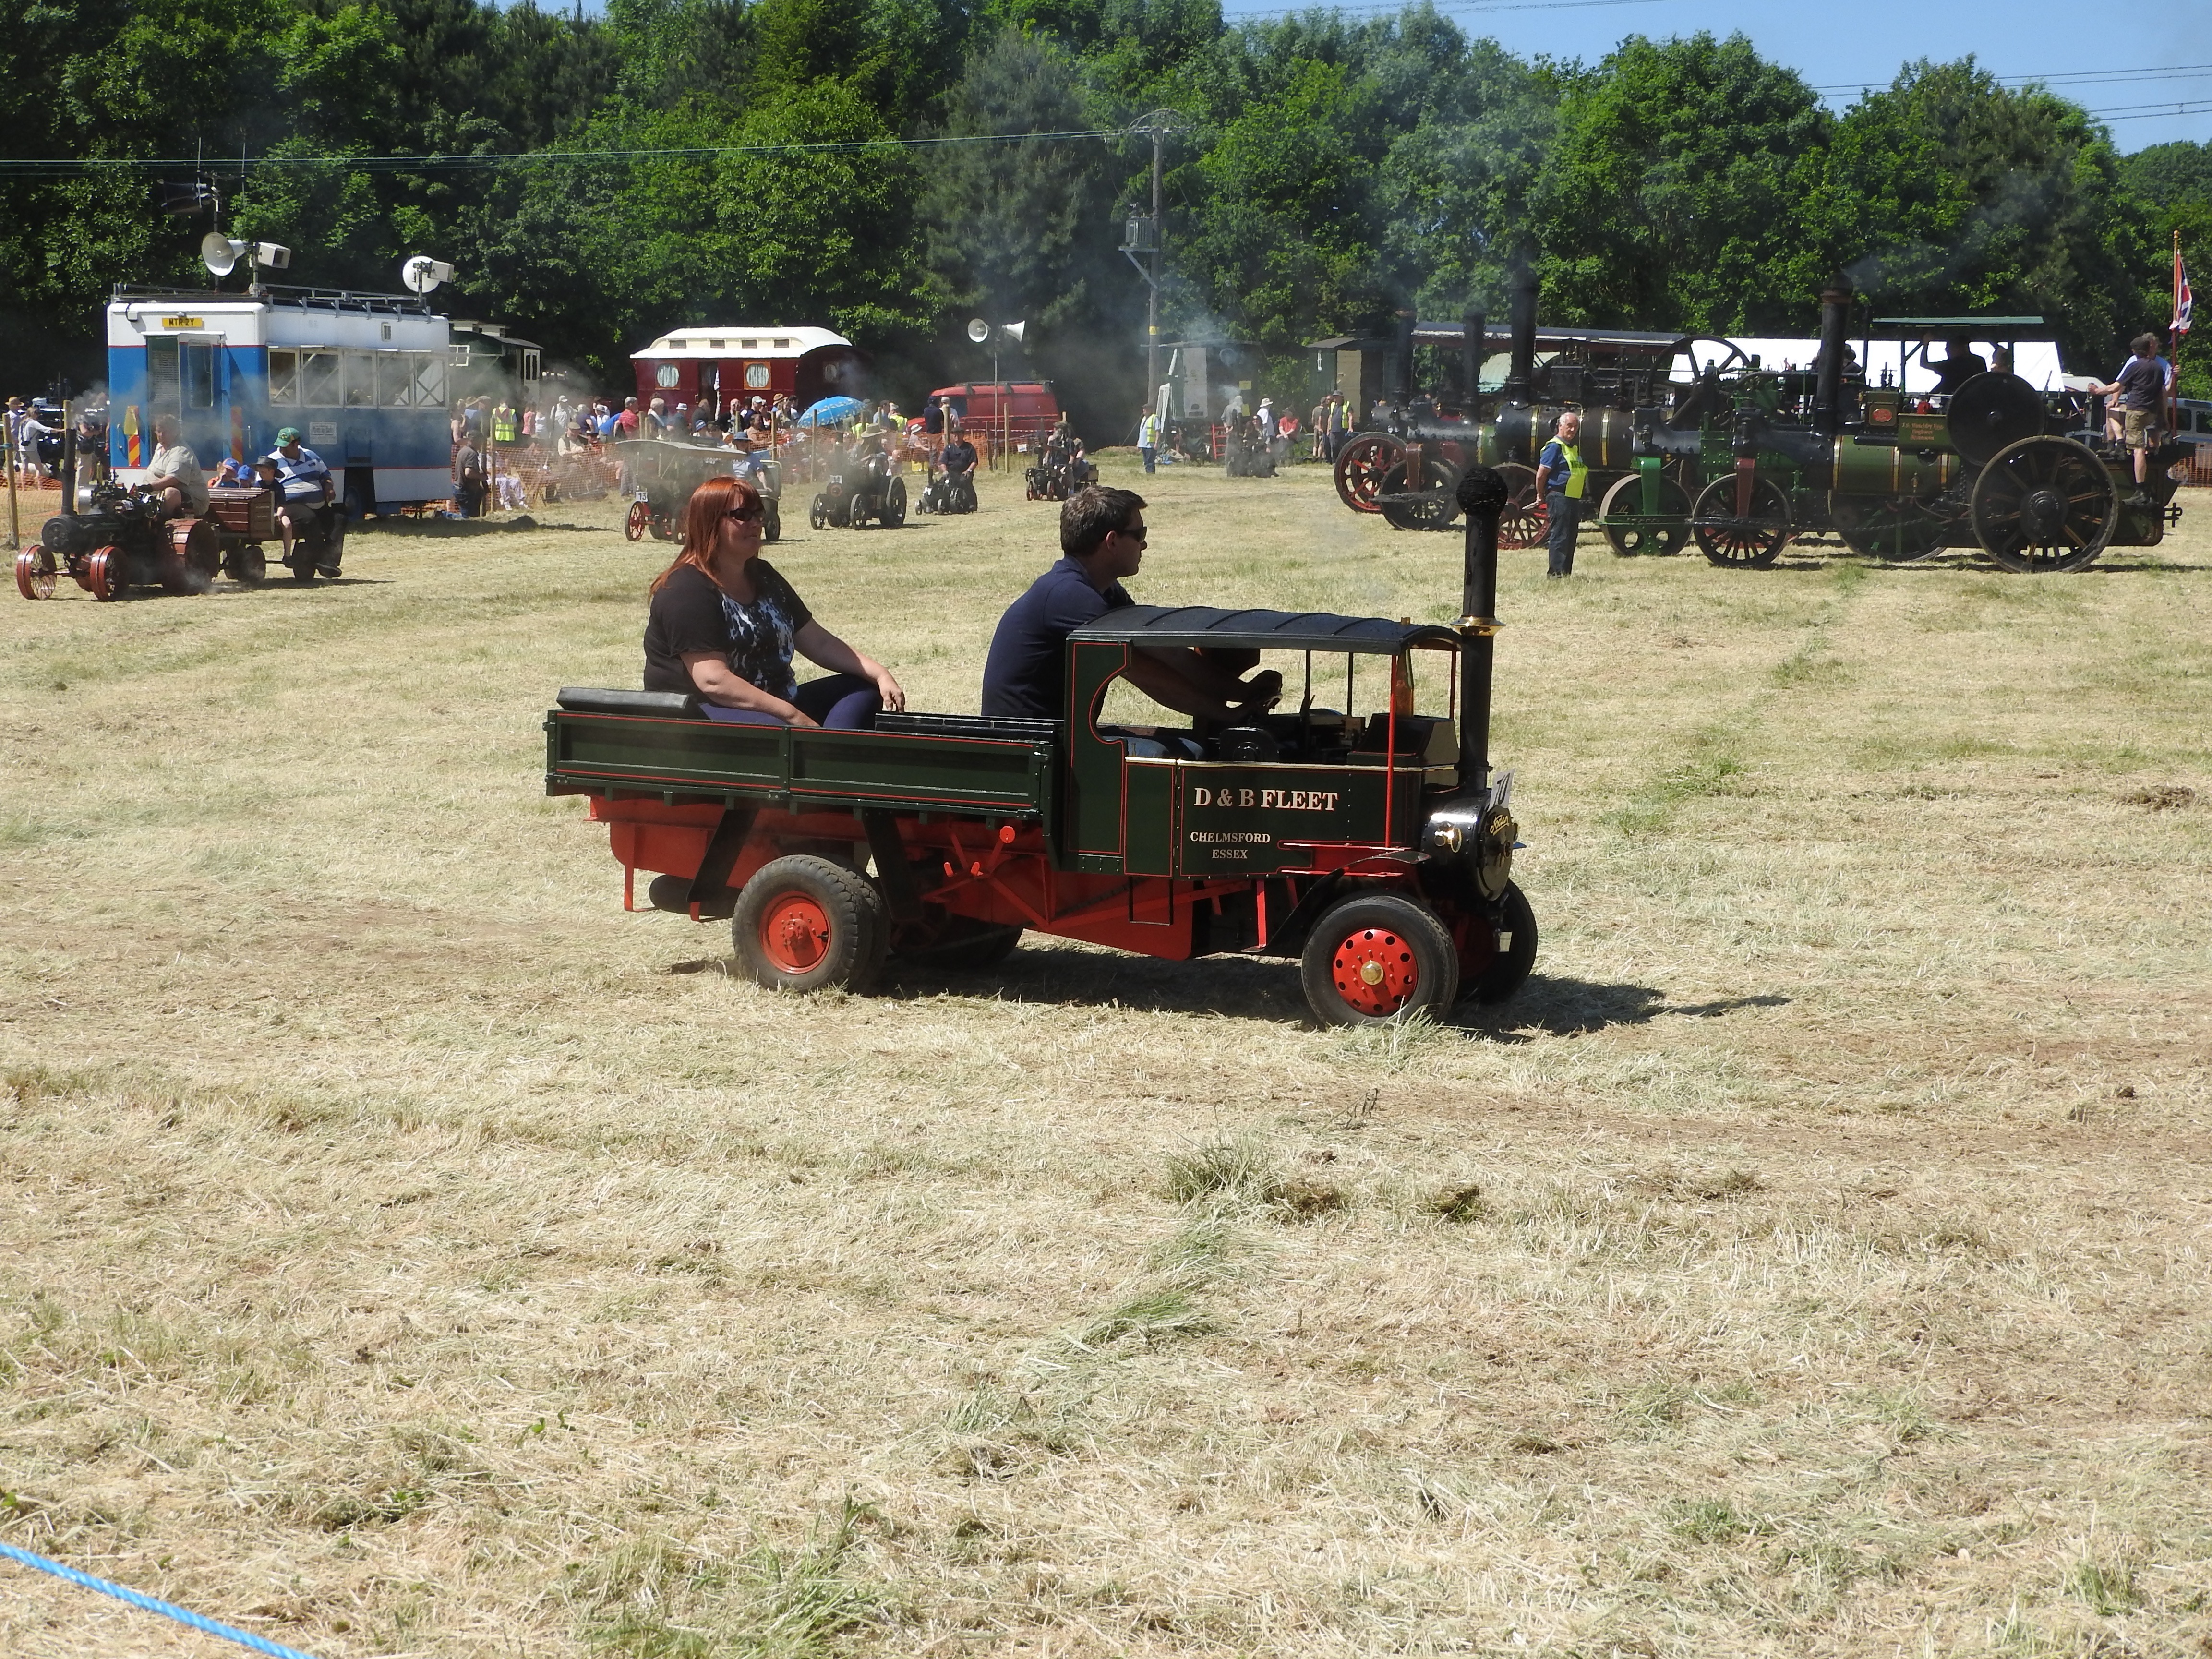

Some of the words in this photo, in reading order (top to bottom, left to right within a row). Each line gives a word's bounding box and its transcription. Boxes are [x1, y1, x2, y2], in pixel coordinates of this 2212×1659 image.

[1493, 772, 1511, 806] 10
[1194, 787, 1211, 806] D
[1217, 788, 1233, 807] &
[1238, 789, 1254, 807] B
[1261, 789, 1339, 811] FLEET
[1190, 831, 1271, 843] CHELMSFORD
[1212, 849, 1248, 859] ESSEX
